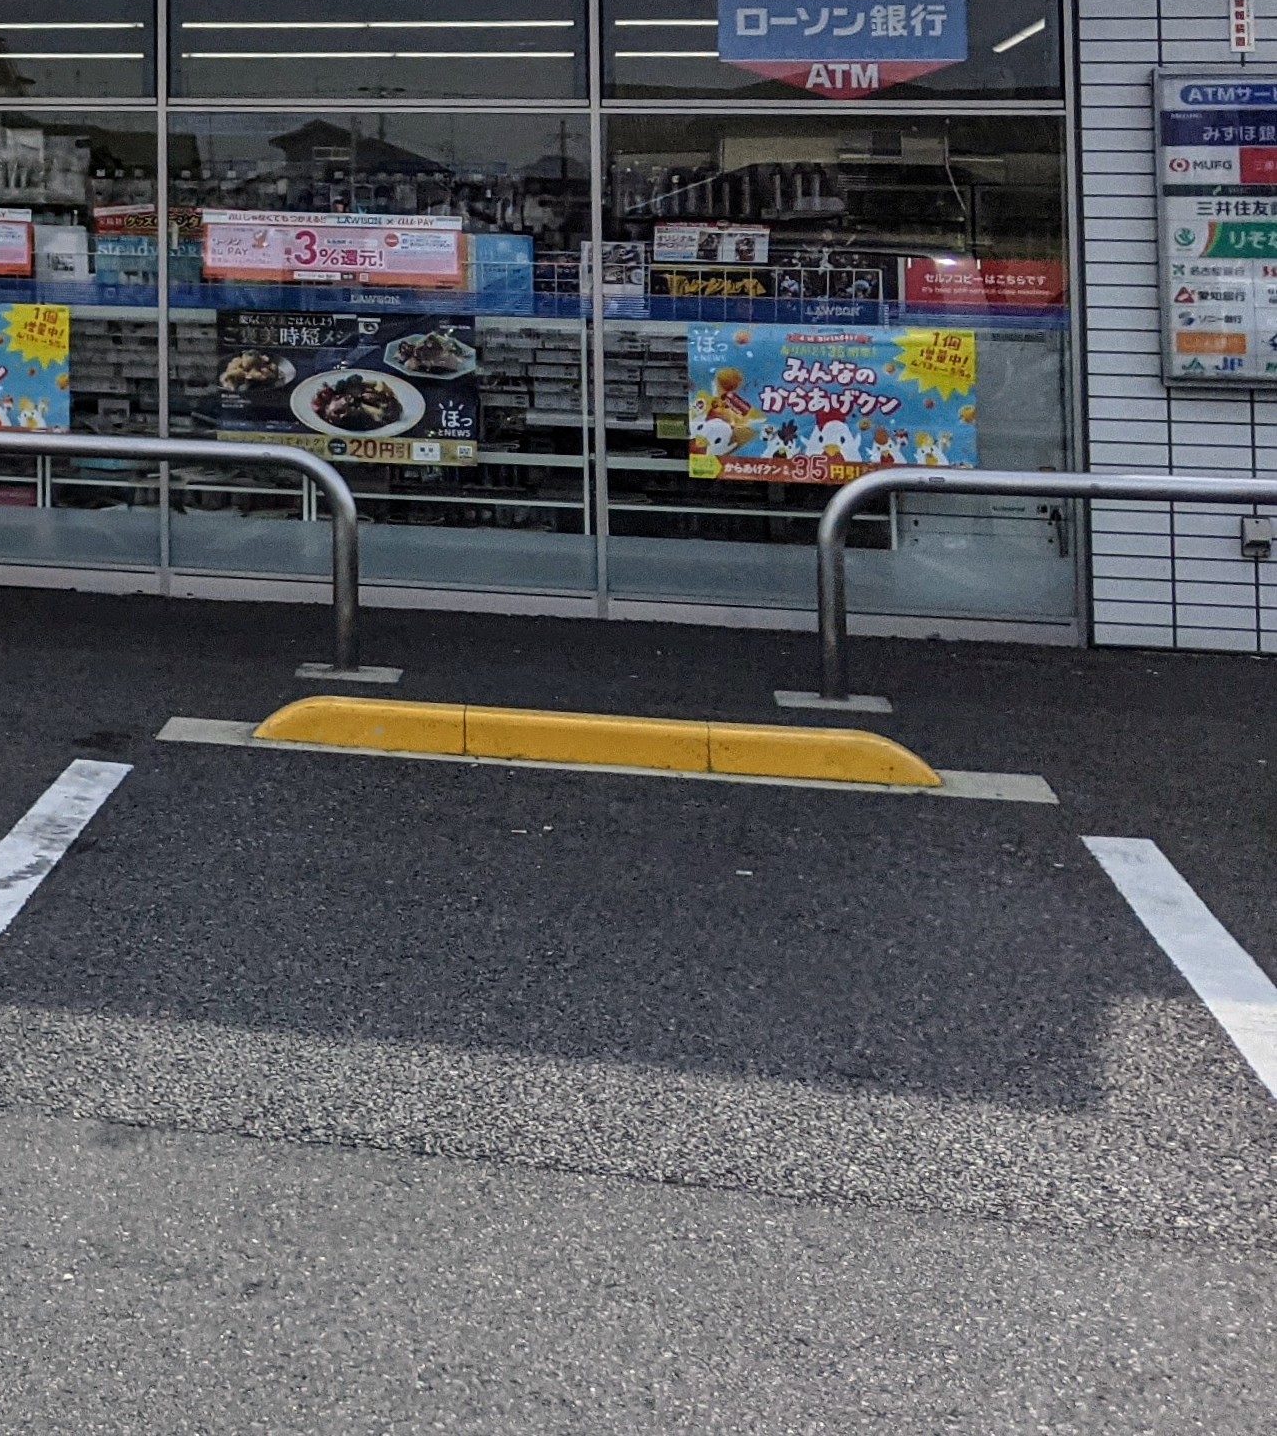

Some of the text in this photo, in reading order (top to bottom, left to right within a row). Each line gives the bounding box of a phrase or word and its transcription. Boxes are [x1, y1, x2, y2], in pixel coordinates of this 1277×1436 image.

[736, 4, 947, 37] ローソン銀行
[805, 63, 879, 89] ATM
[1192, 160, 1232, 170] MUFG
[336, 216, 382, 225] LAWSON
[416, 218, 434, 226] PAY
[228, 247, 248, 255] PAY
[924, 273, 1046, 285] セルフコピーはこちらです
[350, 294, 400, 304] LAWSON
[34, 307, 58, 324] 1個
[697, 337, 728, 353] ほっ
[933, 332, 961, 351] 1個
[920, 348, 968, 367] 増量中!
[782, 356, 877, 385] みんなの
[759, 386, 900, 416] からあげクン
[442, 409, 473, 427] ほっ
[438, 428, 471, 438] とNEWS
[724, 463, 781, 475] からあげクン
